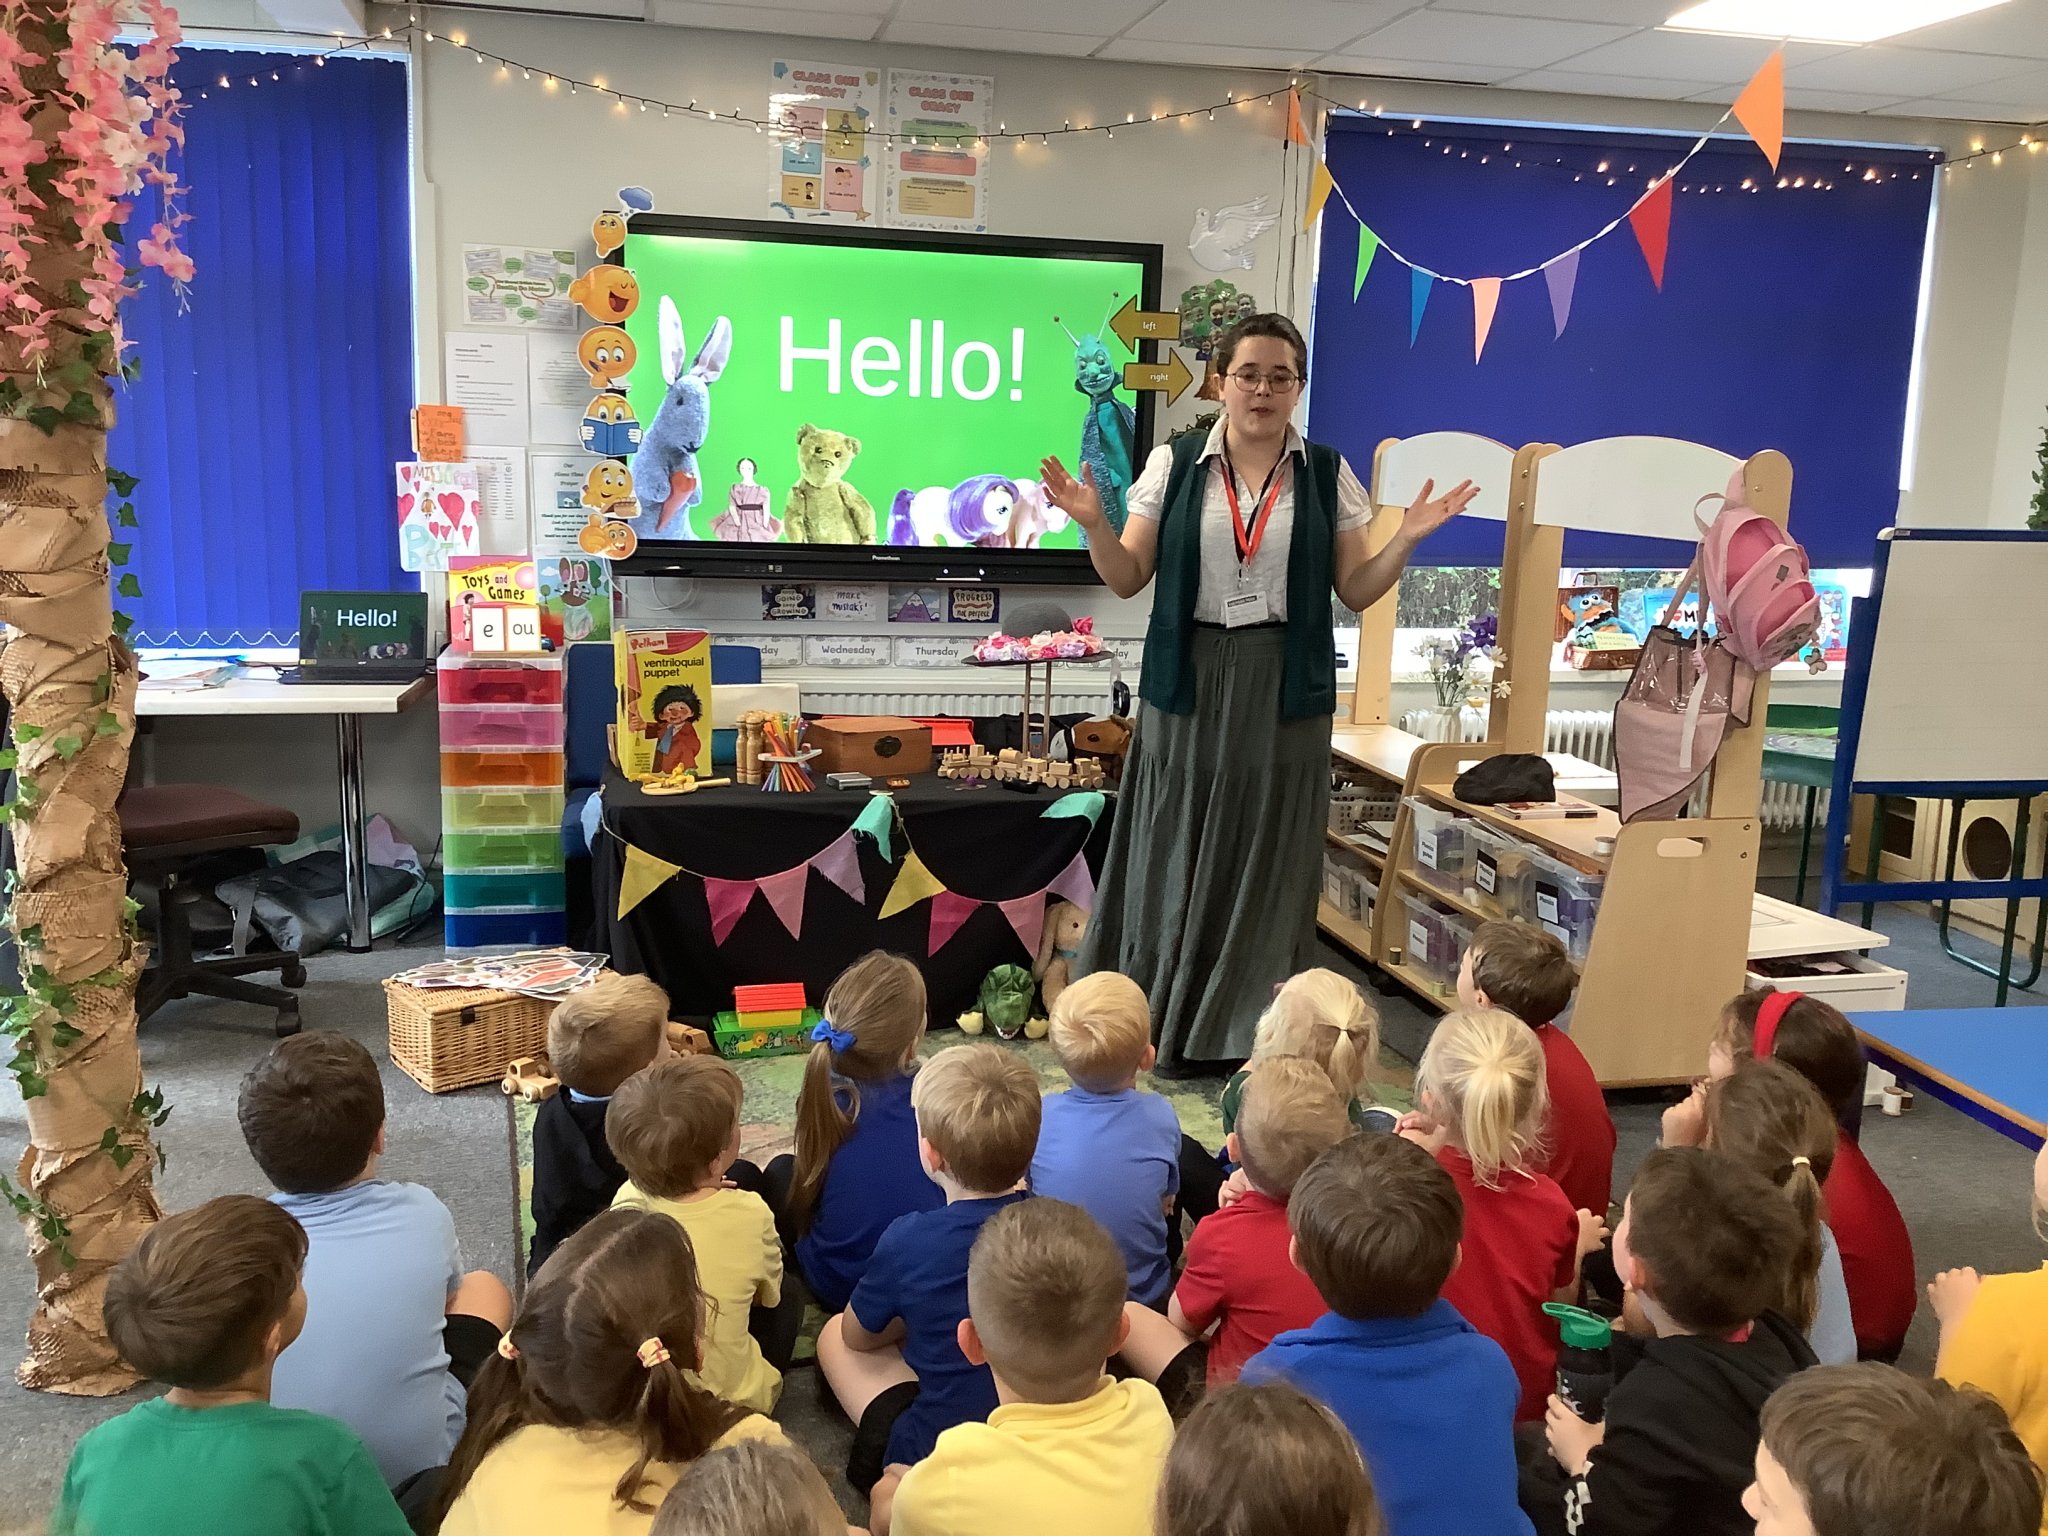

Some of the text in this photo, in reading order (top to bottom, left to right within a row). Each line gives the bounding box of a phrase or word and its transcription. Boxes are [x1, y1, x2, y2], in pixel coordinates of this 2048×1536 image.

[793, 70, 860, 87] CLASS ONE
[909, 86, 974, 102] CLASS ONE
[921, 100, 961, 114] ORACY
[1142, 321, 1156, 331] left
[779, 315, 1025, 402] Hello!
[1150, 373, 1169, 382] right
[461, 574, 508, 589] Toys and
[488, 586, 525, 600] Games
[956, 592, 992, 602] PROGRESS
[772, 607, 807, 615] GROWING
[957, 609, 990, 620] not perfect
[337, 609, 397, 627] Hello!
[483, 624, 494, 638] e
[512, 623, 535, 636] ou
[630, 638, 665, 651] Pelham
[821, 645, 876, 656] Wednesday
[915, 647, 959, 657] Thursday
[643, 657, 704, 668] ventriloquial
[643, 667, 680, 679] puppet
